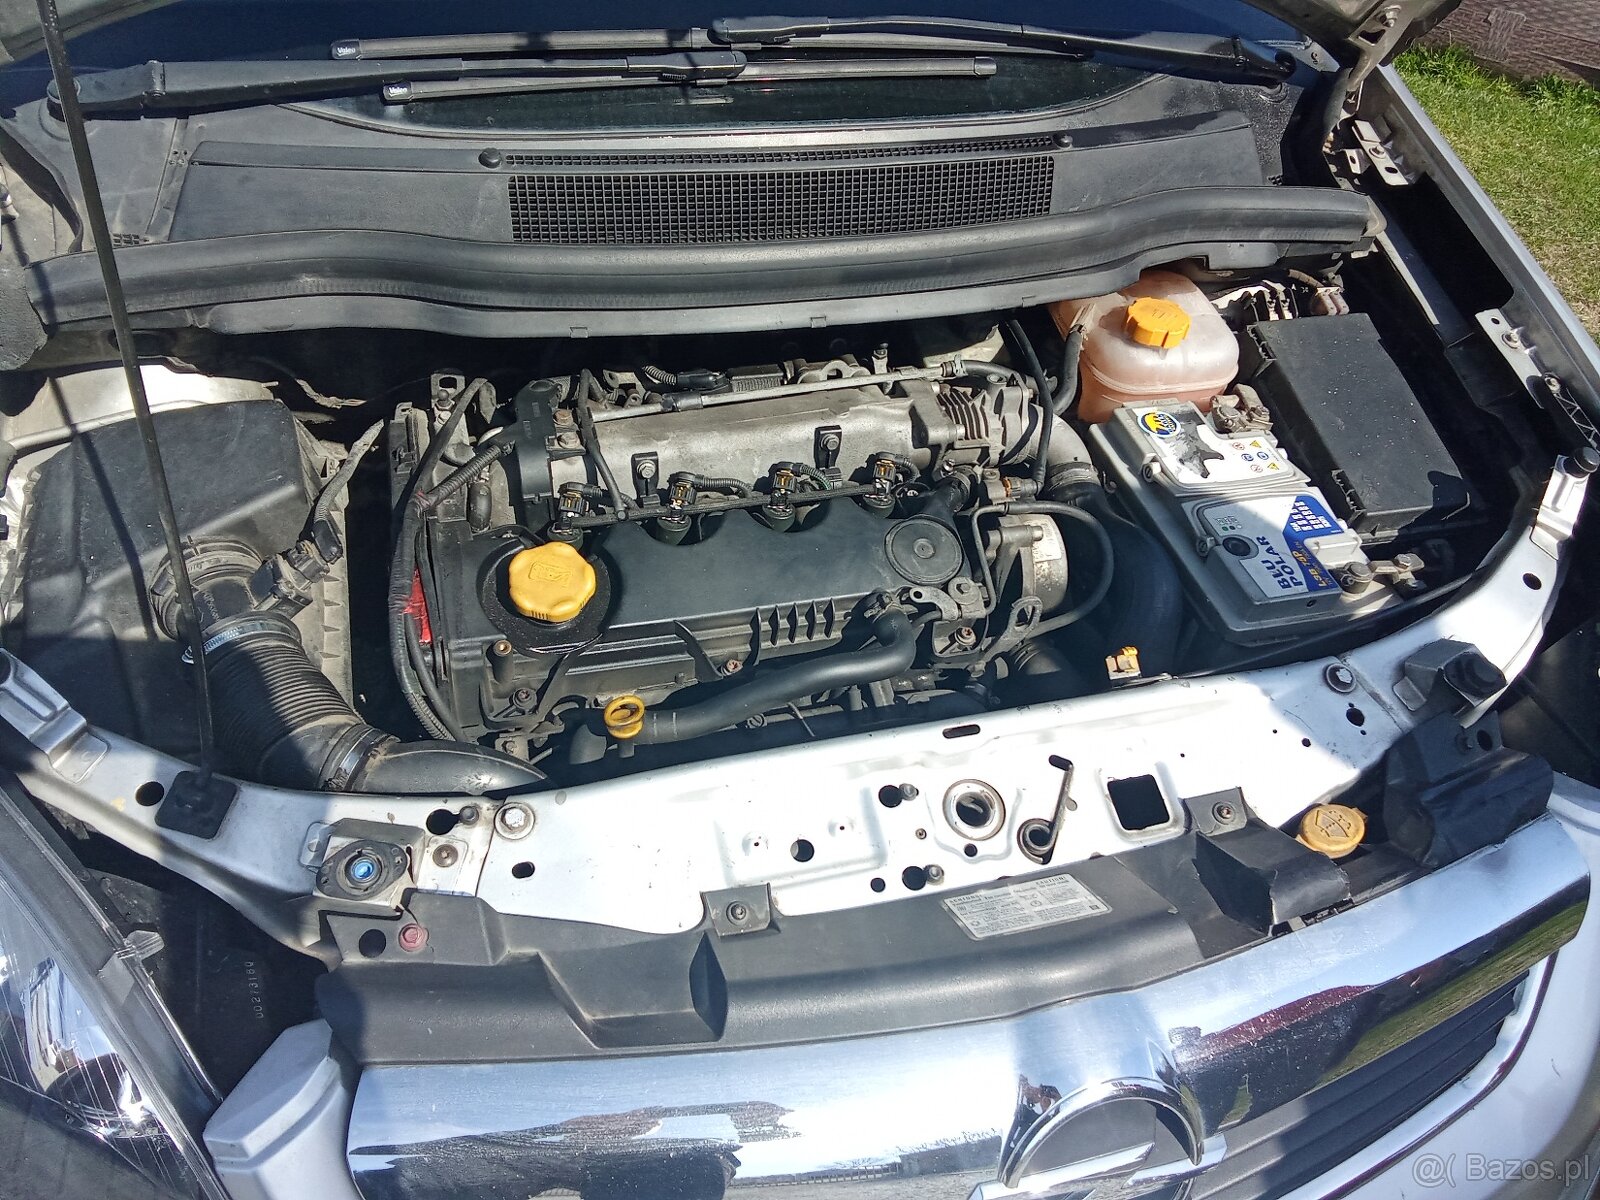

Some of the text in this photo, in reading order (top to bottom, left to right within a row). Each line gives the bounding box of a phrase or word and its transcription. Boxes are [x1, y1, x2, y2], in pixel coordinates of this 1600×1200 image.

[337, 47, 356, 55] Valeo
[388, 87, 408, 95] Valeo
[1256, 536, 1303, 586] POLAR
[1261, 560, 1292, 589] BLU
